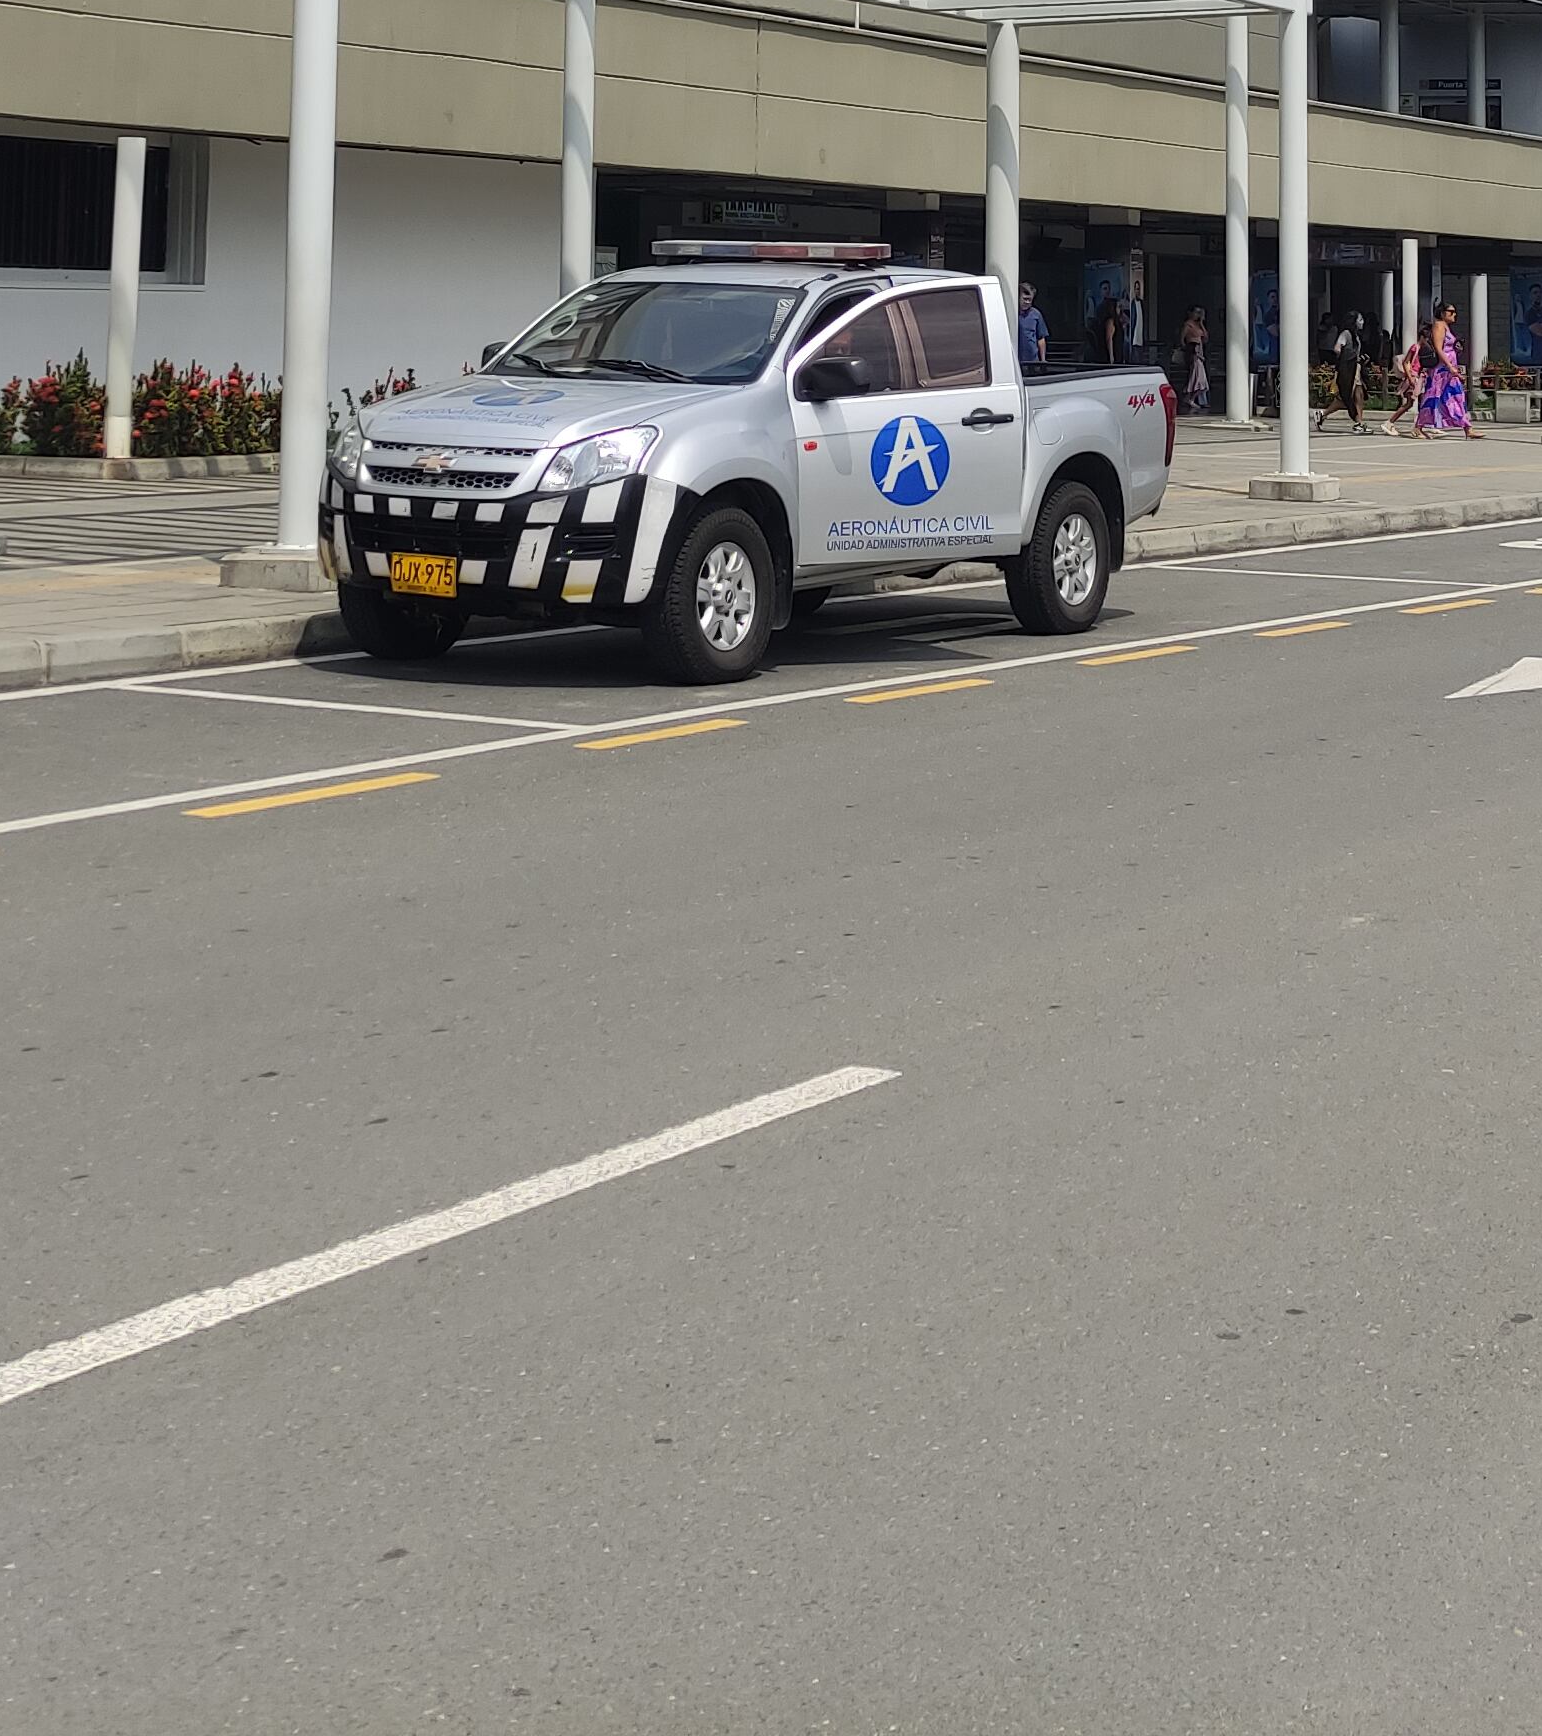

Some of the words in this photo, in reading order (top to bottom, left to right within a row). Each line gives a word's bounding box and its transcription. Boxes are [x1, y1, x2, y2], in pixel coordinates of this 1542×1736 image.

[828, 516, 950, 537] AERONÁUTICA
[953, 515, 994, 531] CIVIL
[826, 539, 864, 551] UNIDAD
[866, 536, 946, 550] ADMINISTRATIVA
[947, 535, 994, 546] ESPECIAL
